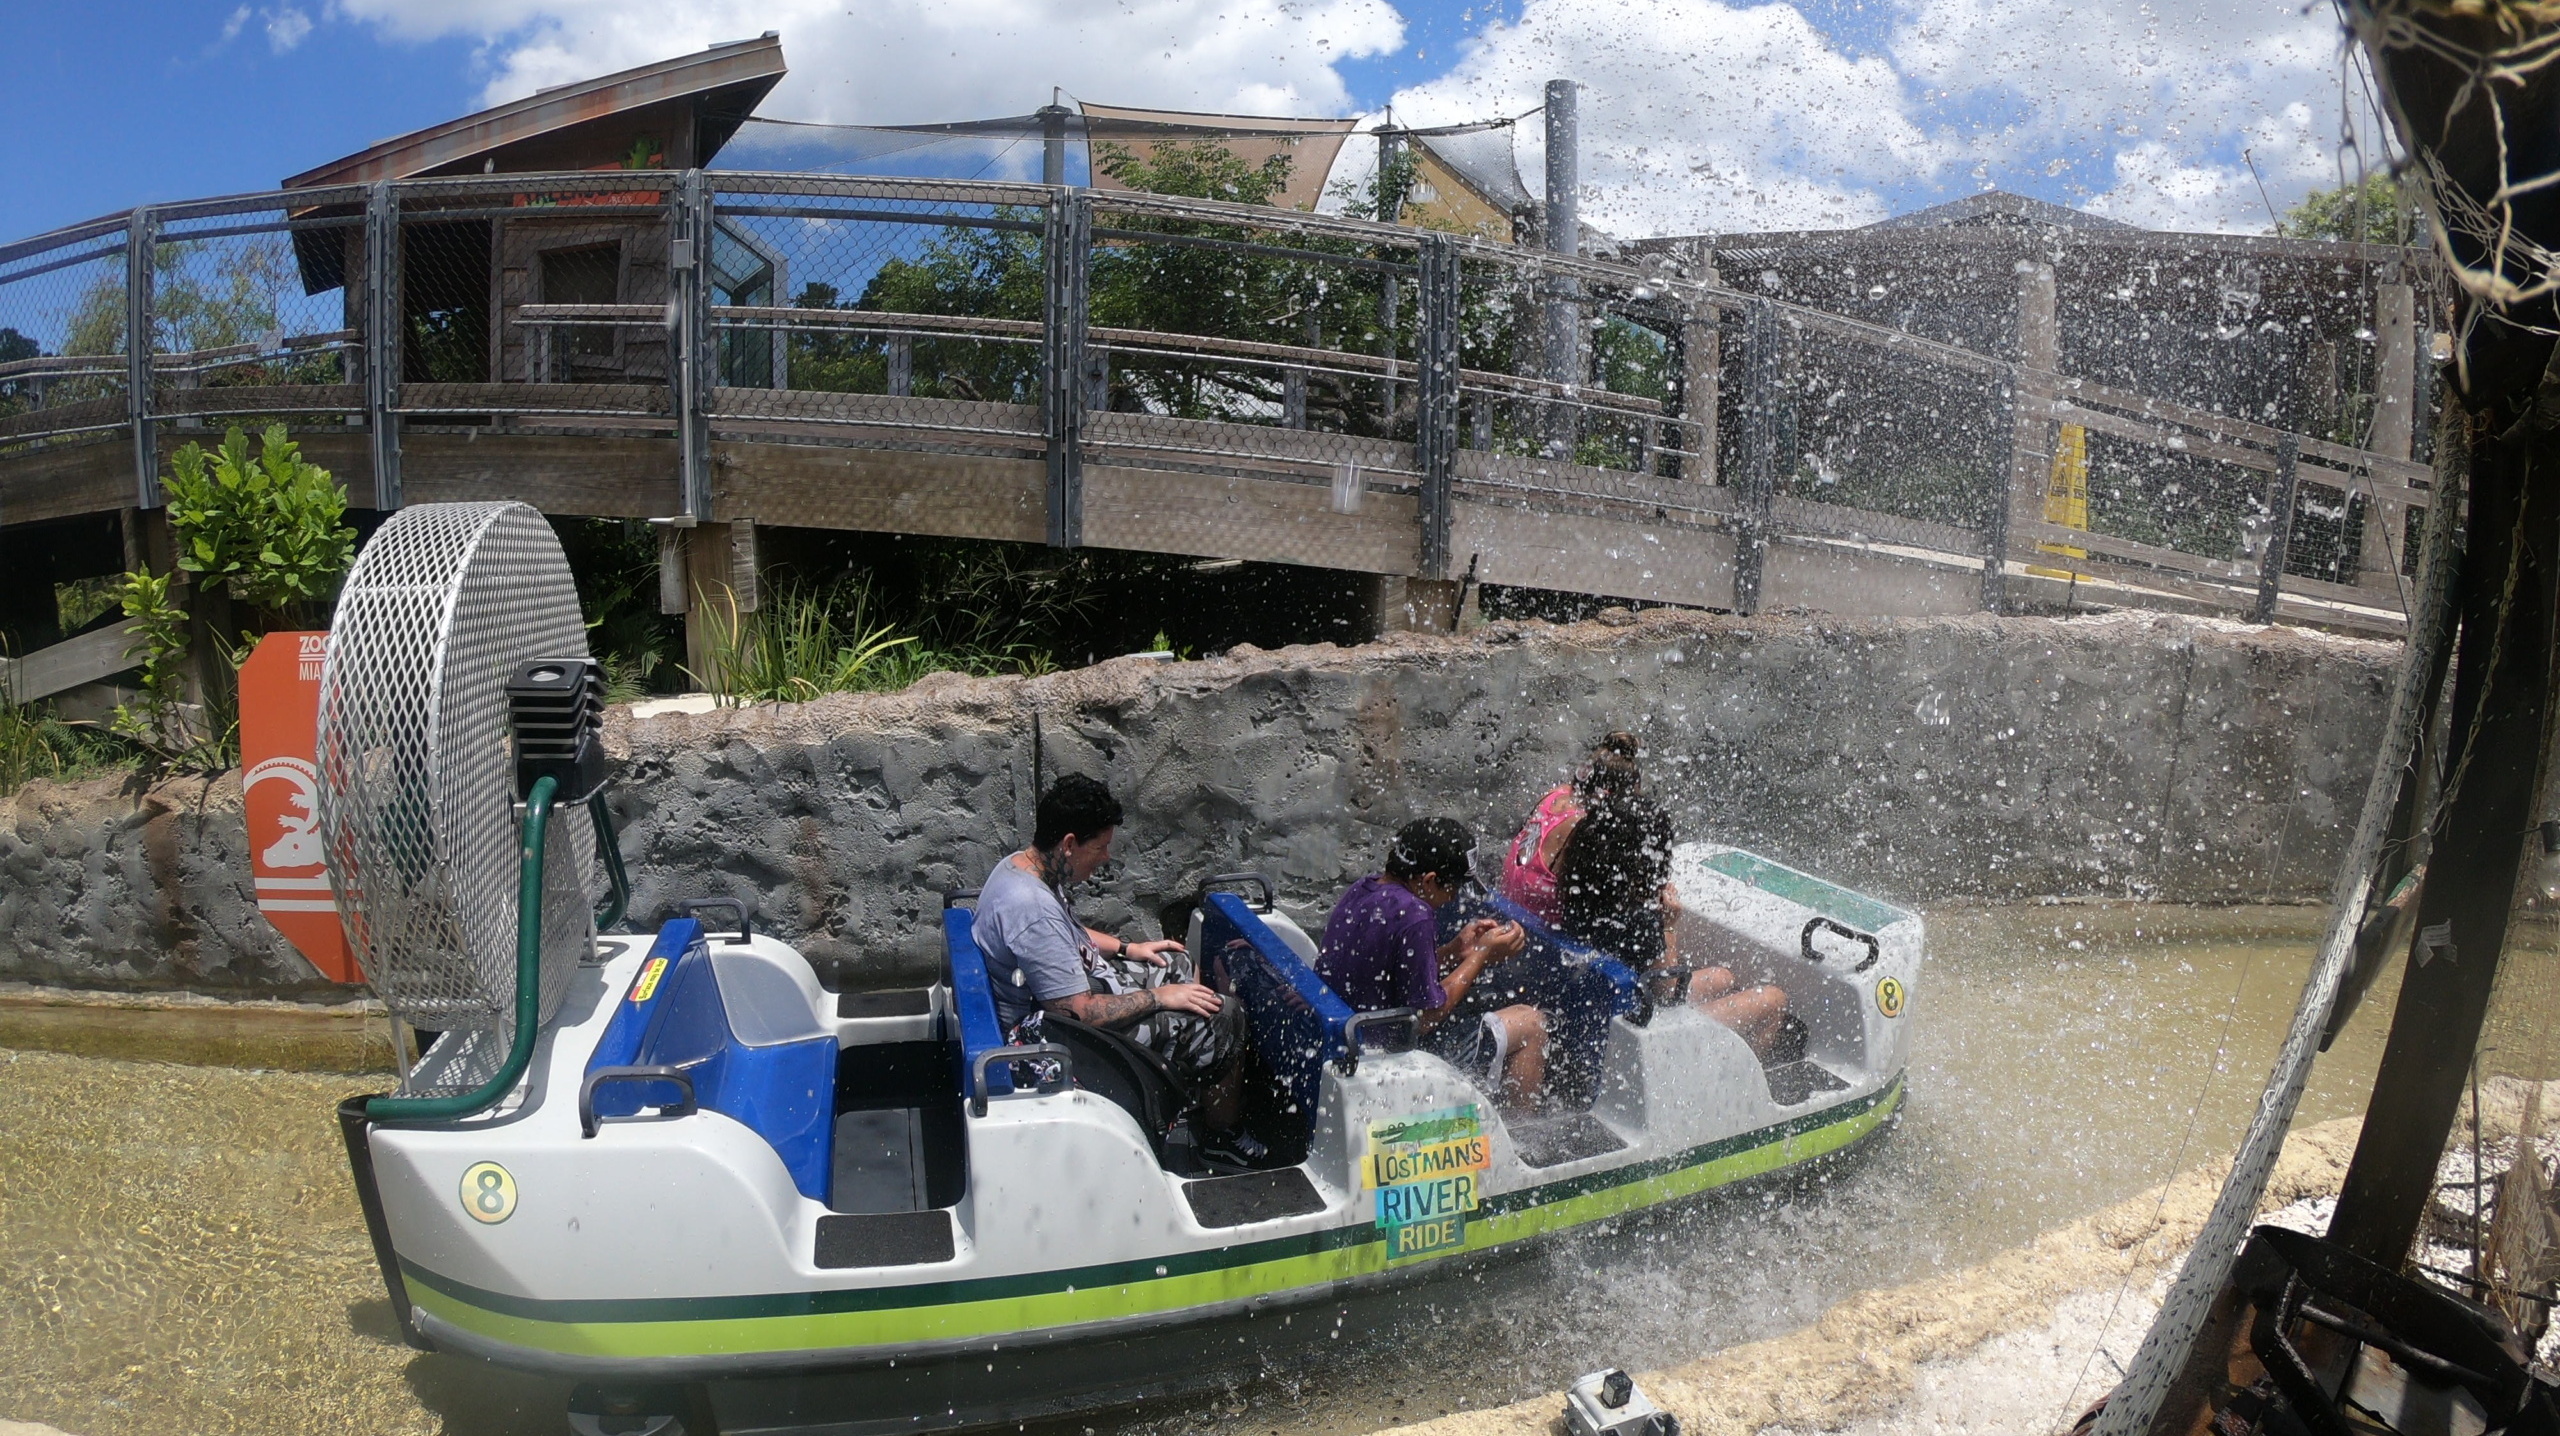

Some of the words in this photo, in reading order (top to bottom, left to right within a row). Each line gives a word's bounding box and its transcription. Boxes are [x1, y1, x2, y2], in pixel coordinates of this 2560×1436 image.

[1883, 982, 1899, 1011] 8
[1373, 1138, 1483, 1188] LOSTMAN'S
[477, 1169, 505, 1214] 8
[1383, 1175, 1473, 1225] RIVER
[1399, 1219, 1456, 1253] RIDE
